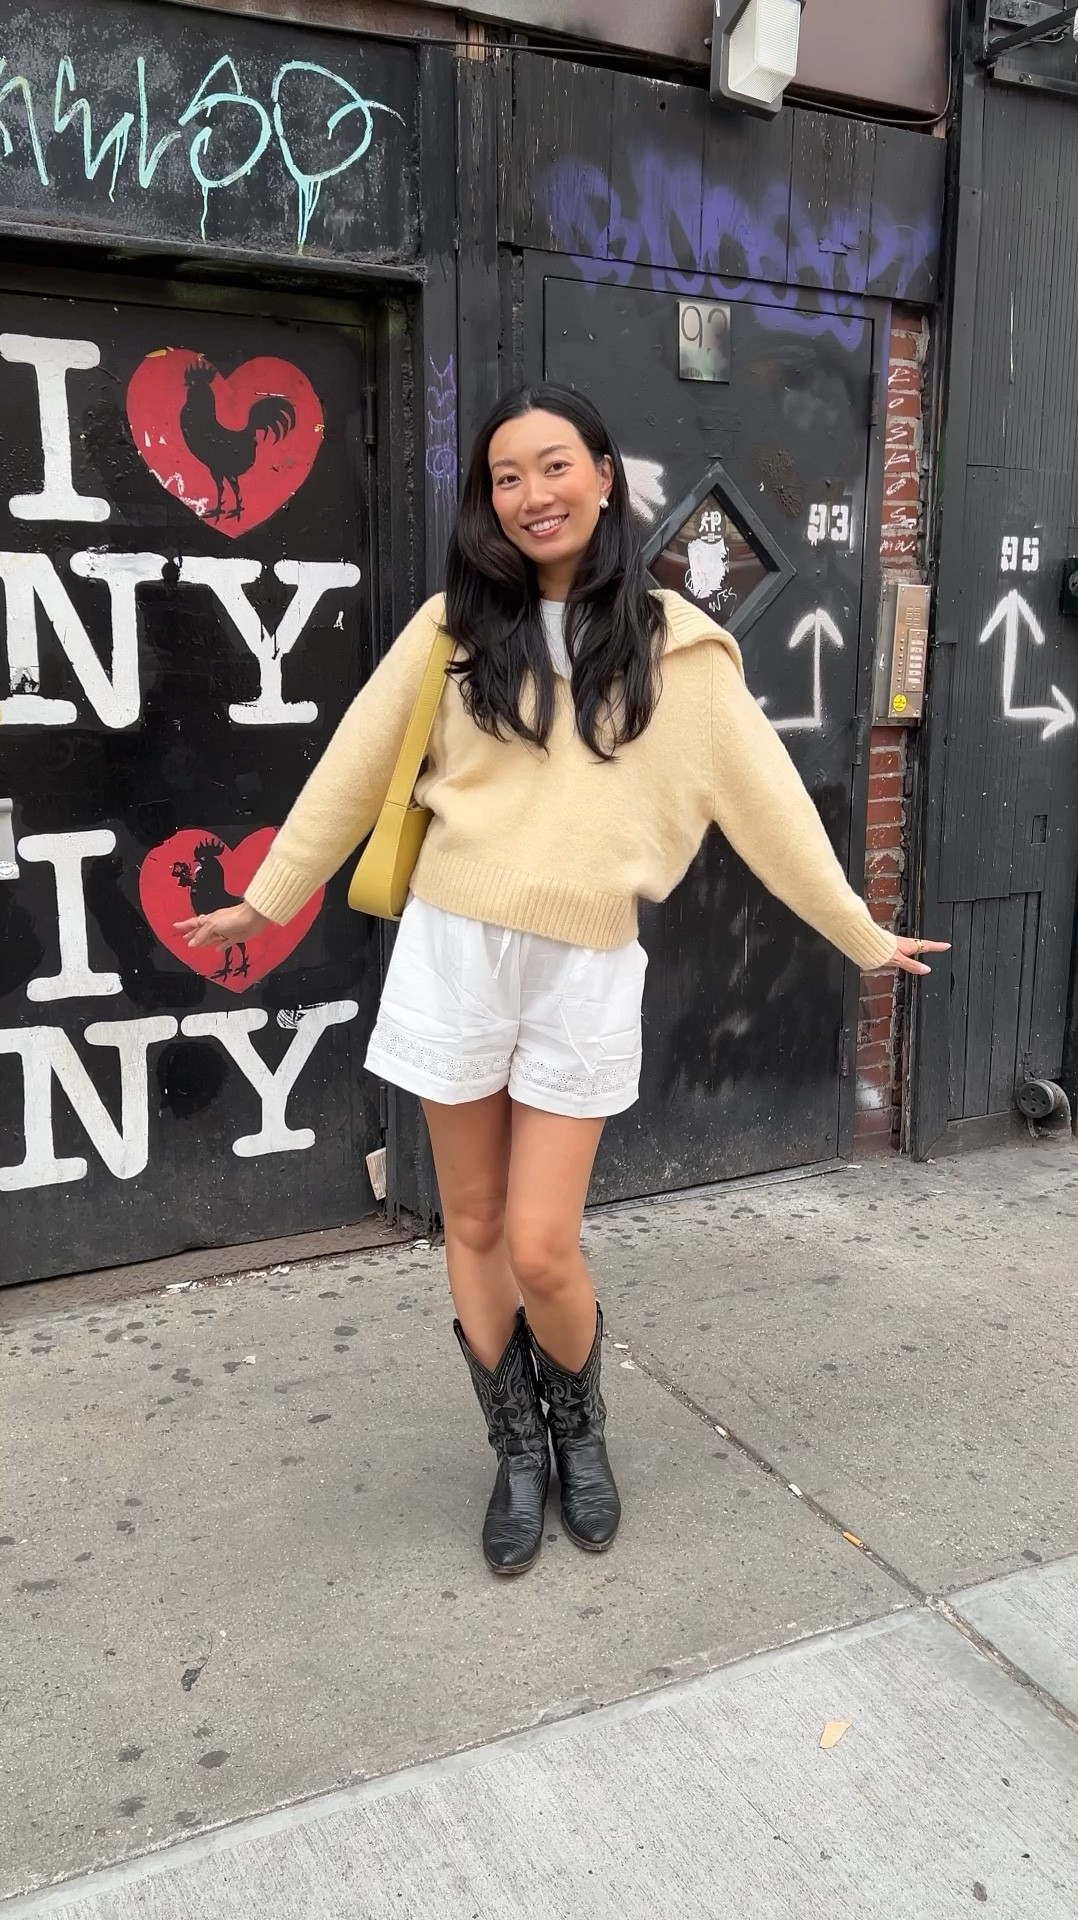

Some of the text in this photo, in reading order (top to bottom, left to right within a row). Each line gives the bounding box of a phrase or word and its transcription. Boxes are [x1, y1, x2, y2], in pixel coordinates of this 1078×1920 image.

[0, 333, 110, 521] I
[808, 504, 848, 543] 93
[1001, 536, 1039, 572] 95
[0, 552, 361, 729] NY
[18, 829, 123, 1002] I
[0, 1000, 359, 1192] NY
